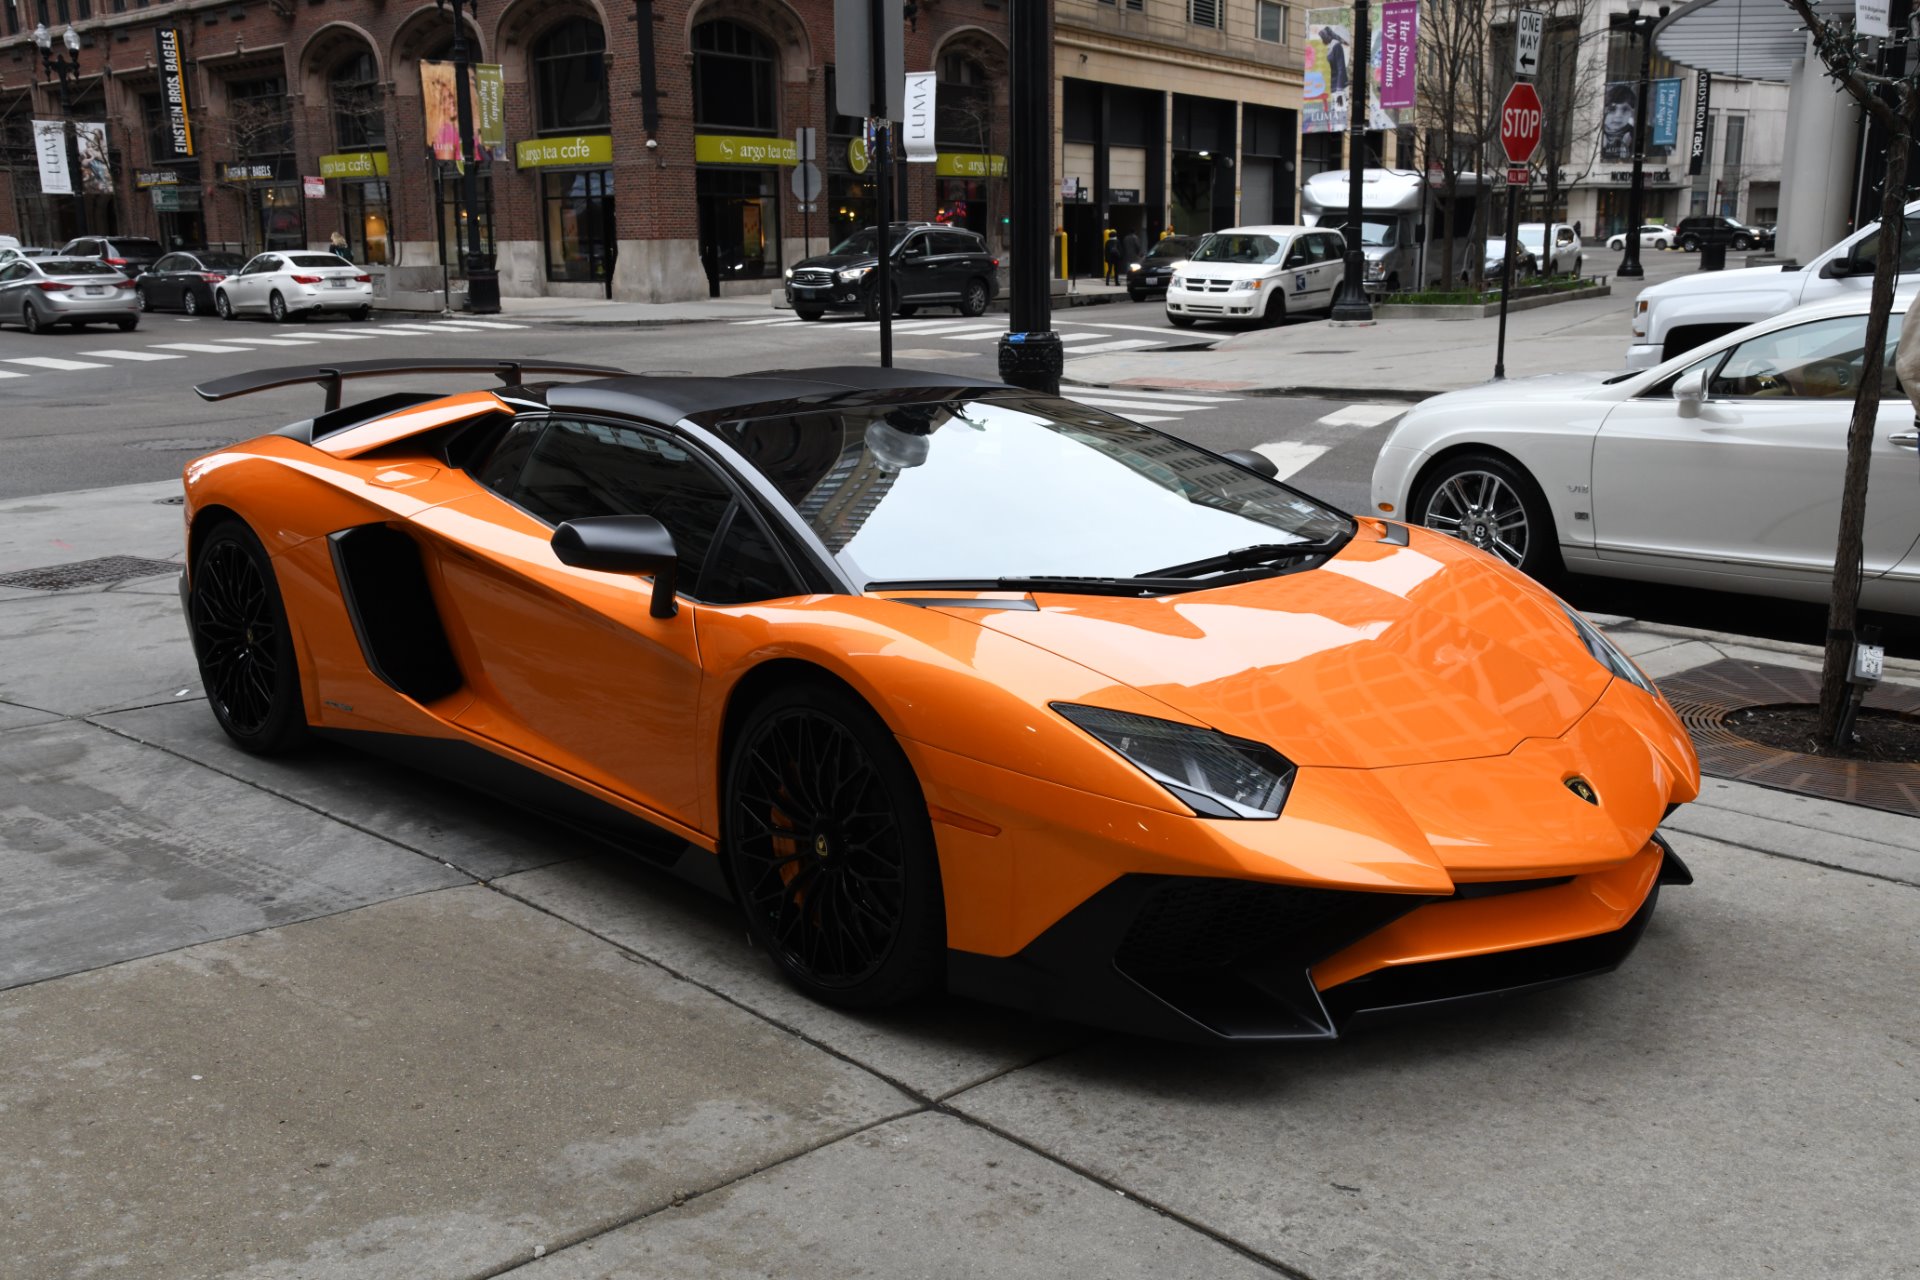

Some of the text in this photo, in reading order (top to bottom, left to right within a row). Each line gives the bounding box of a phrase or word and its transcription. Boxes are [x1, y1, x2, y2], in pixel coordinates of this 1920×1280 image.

[1384, 21, 1398, 40] My
[1399, 20, 1411, 42] Her
[1521, 15, 1541, 33] ONE
[161, 31, 178, 72] BAGELS
[1519, 35, 1540, 51] WAY
[1385, 43, 1397, 88] Dreams
[1396, 45, 1410, 78] Story,
[479, 80, 491, 129] Englewood
[489, 80, 500, 123] Everyday
[911, 78, 928, 139] LUMA
[1311, 112, 1340, 121] LUMA
[1691, 71, 1709, 158] ORDSTROM rack
[171, 106, 188, 153] EINSTEIN
[1503, 107, 1540, 139] STOP
[560, 138, 590, 158] café
[740, 145, 766, 162] argo
[768, 145, 781, 159] tea
